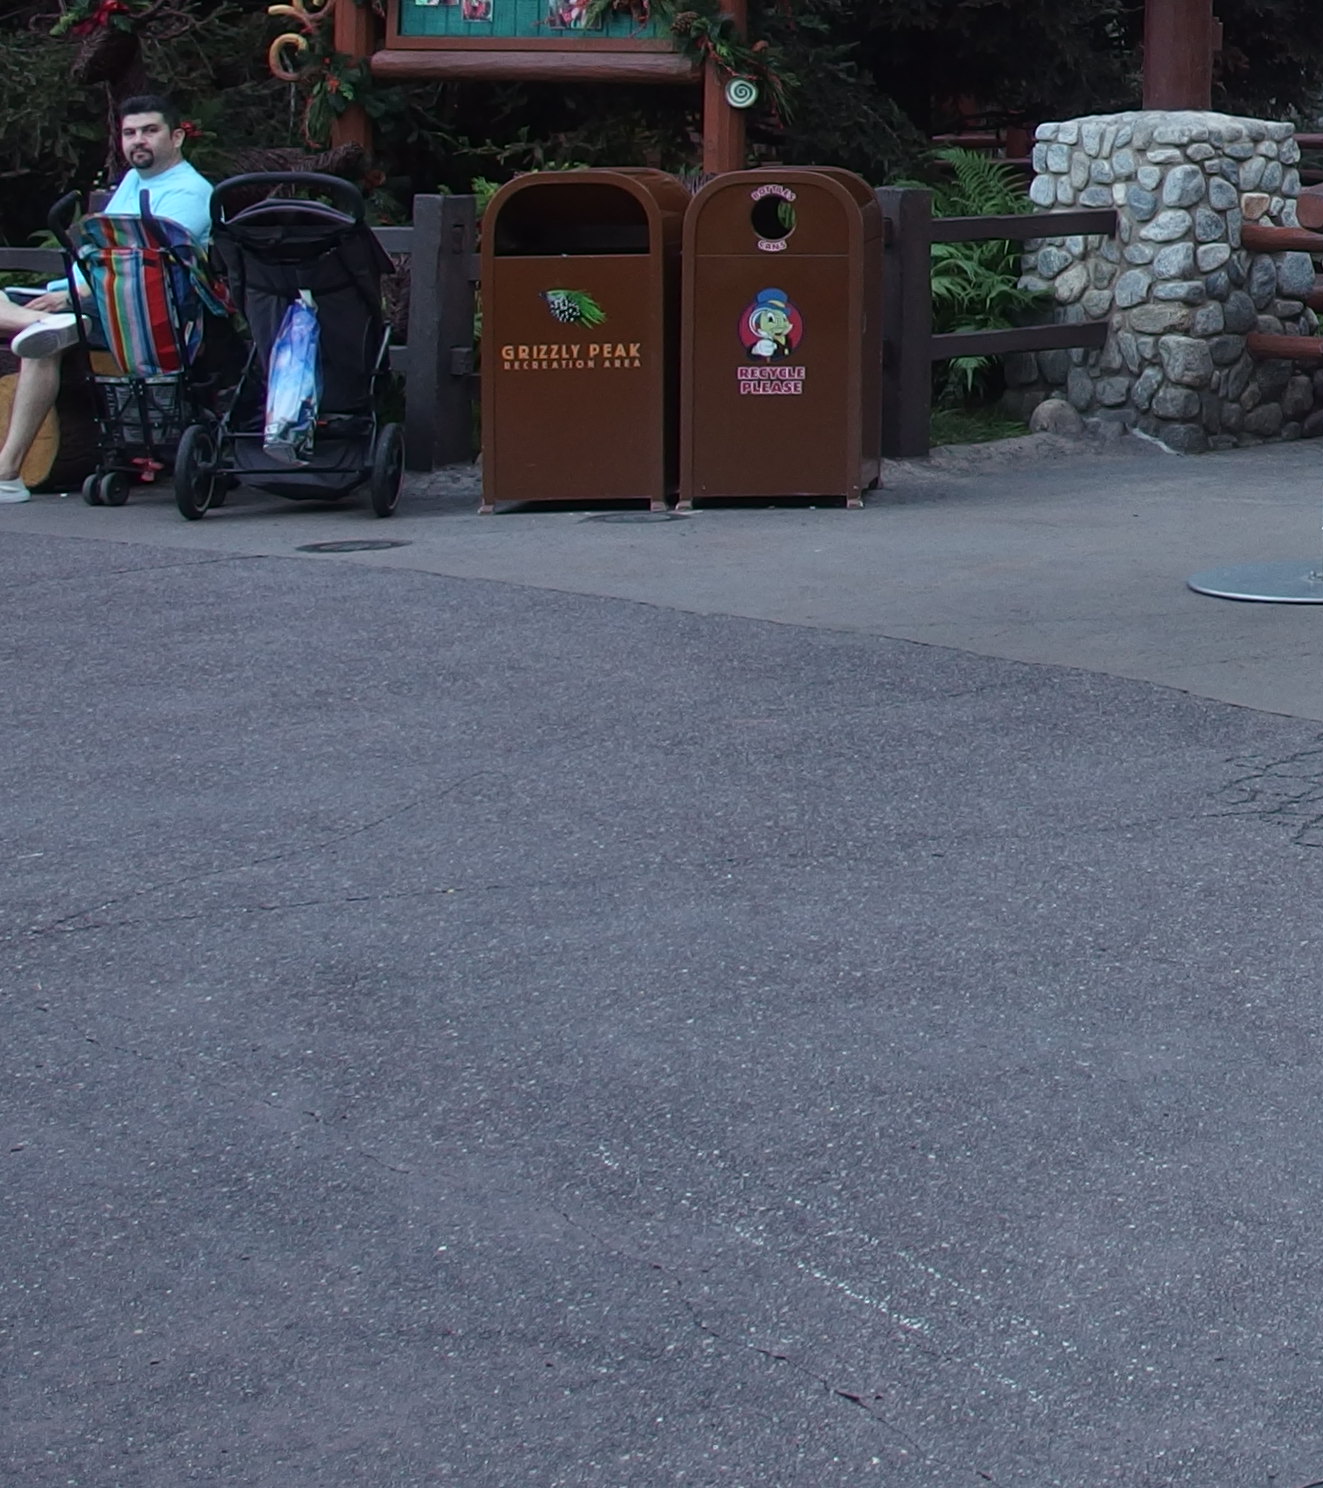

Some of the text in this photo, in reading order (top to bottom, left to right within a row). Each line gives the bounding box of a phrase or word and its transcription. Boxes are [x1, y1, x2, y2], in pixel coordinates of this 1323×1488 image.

[751, 184, 797, 202] BOTTLES
[758, 239, 787, 251] CANS
[501, 343, 641, 360] GRIZZLY PEAK
[503, 359, 641, 370] RECREATION AREA
[737, 366, 805, 380] RECYCLE
[740, 380, 803, 394] PLEASE
